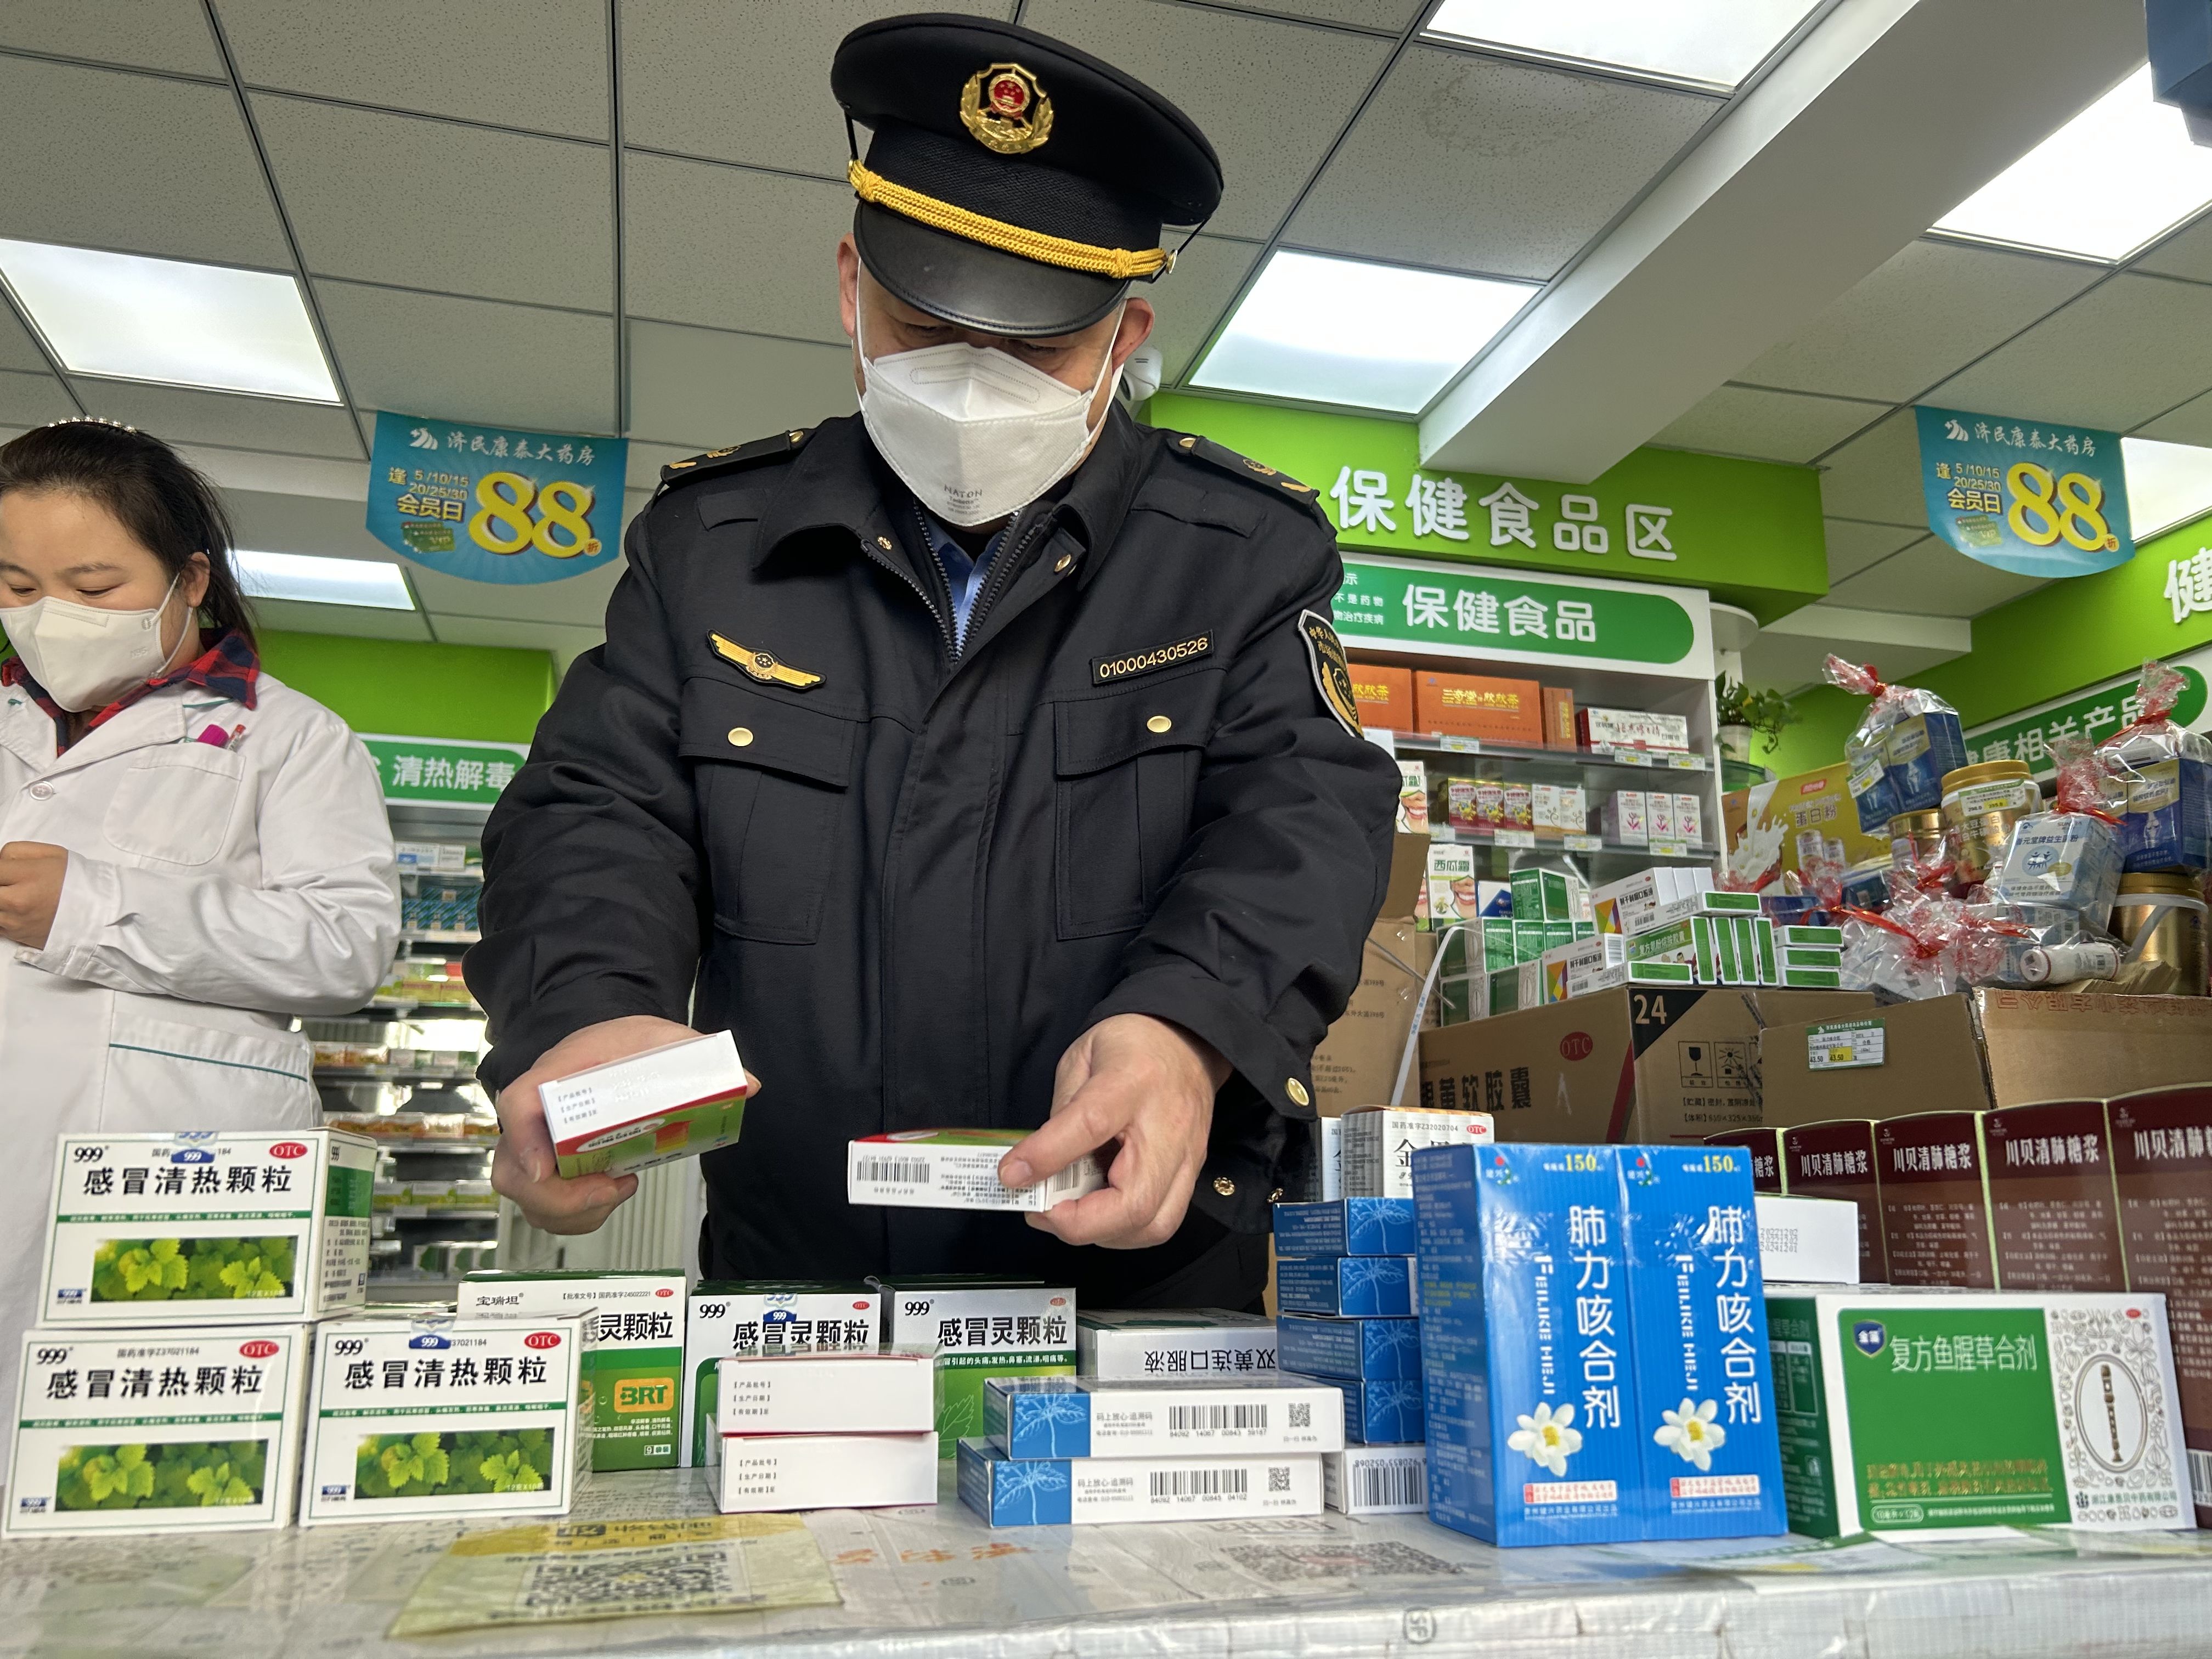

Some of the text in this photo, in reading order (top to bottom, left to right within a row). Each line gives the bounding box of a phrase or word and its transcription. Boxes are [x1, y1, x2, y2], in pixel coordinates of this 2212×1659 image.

[447, 432, 595, 466] 济民康泰大药房
[1974, 421, 2096, 458] 济民康泰大药房
[388, 467, 408, 486] 逢
[1936, 462, 1951, 479] 逢
[1954, 476, 2002, 492] 20/25/30
[409, 482, 468, 500] 20/25/30
[944, 484, 983, 498] NATON
[1948, 489, 2002, 514] 会员日
[396, 494, 465, 522] 会员日
[469, 471, 592, 558] 88
[1330, 466, 1677, 562] 保健食品区
[2006, 461, 2107, 552] 88
[587, 542, 599, 553] 折
[2106, 538, 2118, 550] 折
[1403, 583, 1596, 642] 保健食品
[1099, 637, 1209, 678] 01000430526
[392, 754, 516, 791] 清热解毒
[1434, 859, 1469, 872] 西瓜霜
[1634, 994, 1667, 1025] 24
[1561, 1036, 1591, 1058] OTC
[1468, 1125, 1486, 1133] OTC
[74, 1147, 104, 1163] 999
[273, 1144, 304, 1157] OTC
[184, 1152, 202, 1162] 999
[1800, 1149, 1868, 1177] 川贝清肺糖浆
[1893, 1142, 1972, 1172] 川贝清肺糖浆
[2005, 1133, 2100, 1167] 川贝清肺糖浆
[83, 1164, 293, 1195] 感冒清热颗粒
[476, 1295, 520, 1307] 宝瑞坦
[699, 1304, 726, 1319] 999
[905, 1301, 930, 1316] 999
[1706, 1204, 1762, 1425] 肺力咳合剂
[772, 1311, 787, 1321] 999
[1568, 1205, 1621, 1429] 肺力咳合剂
[421, 1337, 438, 1347] 999
[733, 1319, 870, 1350] 感冒灵颗粒
[938, 1315, 1068, 1347] 感冒灵颗粒
[36, 1348, 67, 1365] 999
[242, 1343, 273, 1356] OTC
[334, 1340, 363, 1356] 999
[527, 1334, 558, 1347] OTC
[1889, 1334, 2038, 1372] 复方鱼腥草合剂
[345, 1357, 548, 1389] 感冒清热颗粒
[1144, 1348, 1276, 1374] 双黄连口服液
[47, 1364, 264, 1400] 感冒清热颗粒
